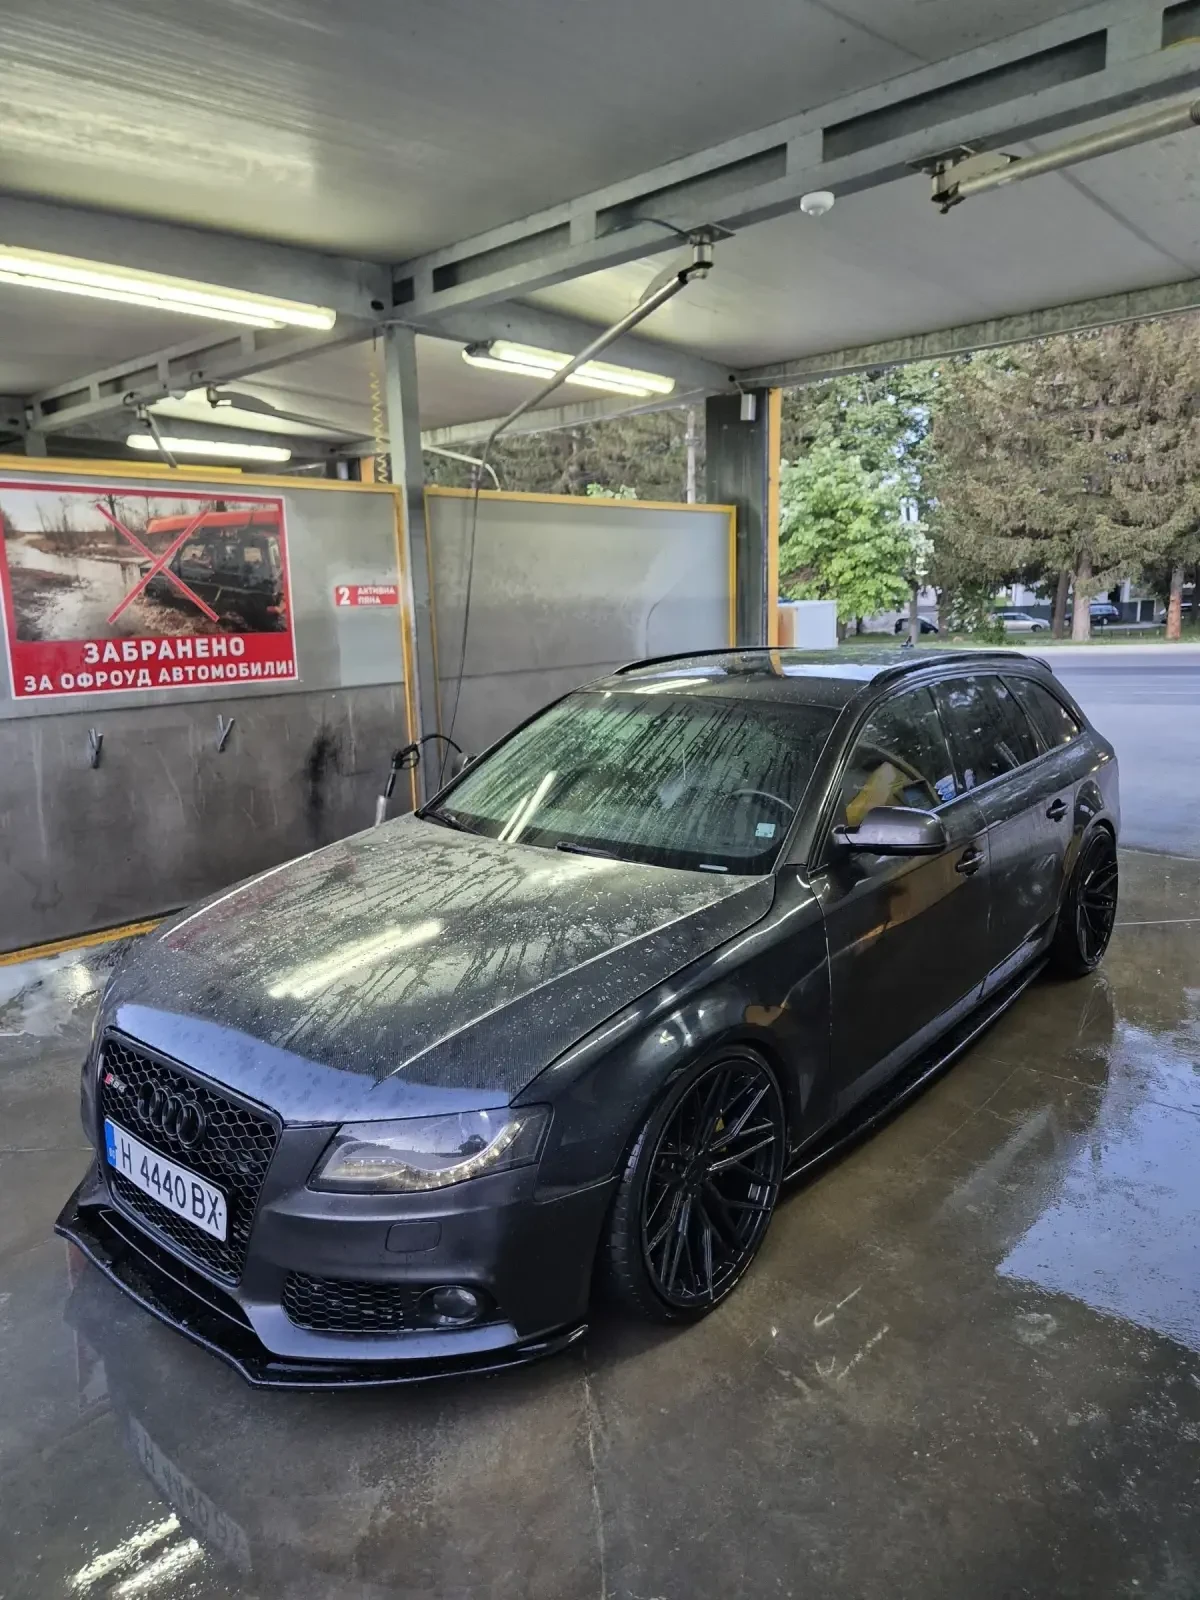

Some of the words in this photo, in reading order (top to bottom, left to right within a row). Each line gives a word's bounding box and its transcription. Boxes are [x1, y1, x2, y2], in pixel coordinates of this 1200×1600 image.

[339, 587, 350, 605] 2
[84, 637, 245, 664] ЗАБРАНЕНО
[24, 674, 53, 692] ЗА
[61, 668, 151, 688] ОФРОУД
[158, 660, 294, 684] АВТОМОБИЛИ!
[121, 1137, 132, 1174] H
[140, 1155, 187, 1209] 4440
[191, 1180, 219, 1230] BX
